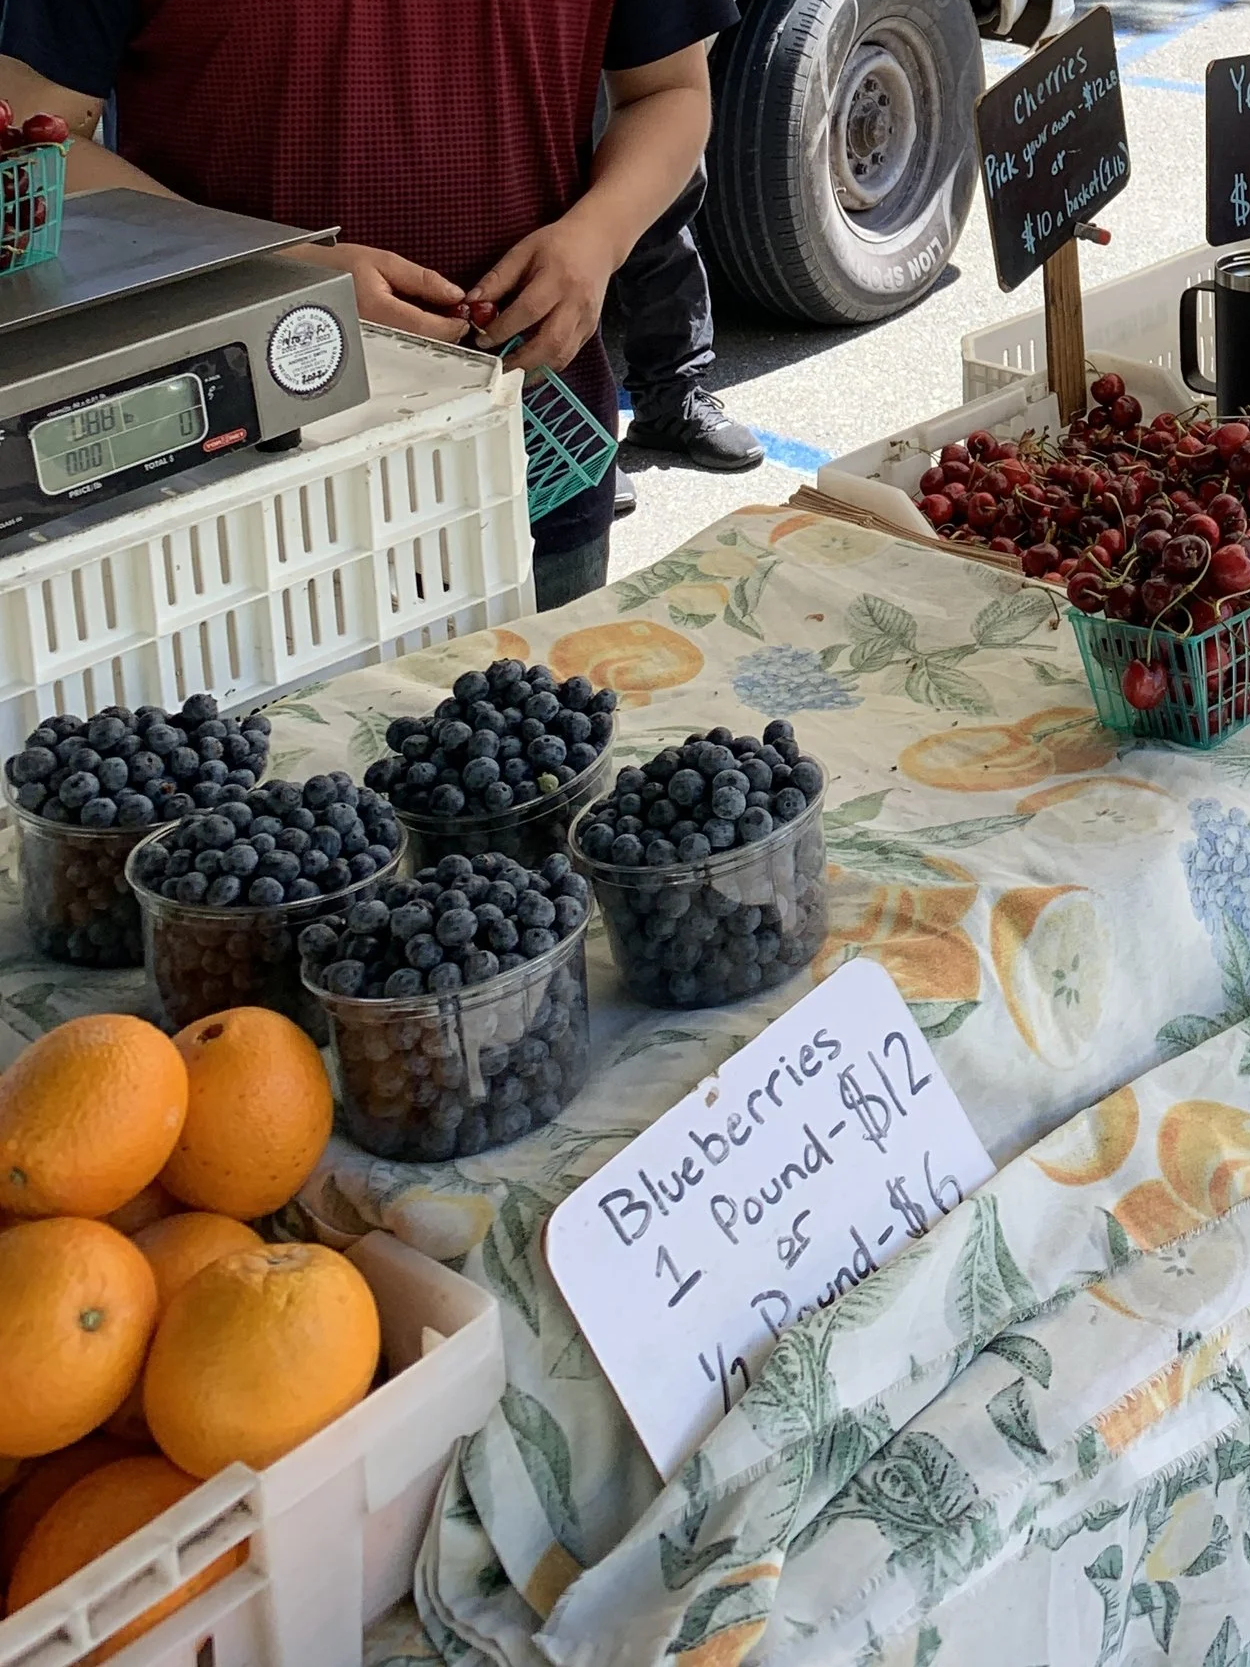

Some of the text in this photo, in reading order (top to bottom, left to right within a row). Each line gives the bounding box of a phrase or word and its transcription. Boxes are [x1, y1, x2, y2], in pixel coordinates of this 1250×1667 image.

[1014, 46, 1088, 125] Cherries
[984, 151, 1019, 199] Pick
[1022, 124, 1049, 179] your
[1051, 108, 1077, 135] own
[1051, 149, 1066, 176] or
[906, 236, 946, 281] LION
[1020, 207, 1052, 254] $10
[1056, 210, 1064, 227] a
[144, 457, 168, 472] TOTAL
[598, 1027, 843, 1246] Blueberries
[777, 1208, 811, 1271] or
[654, 1245, 704, 1308] 1
